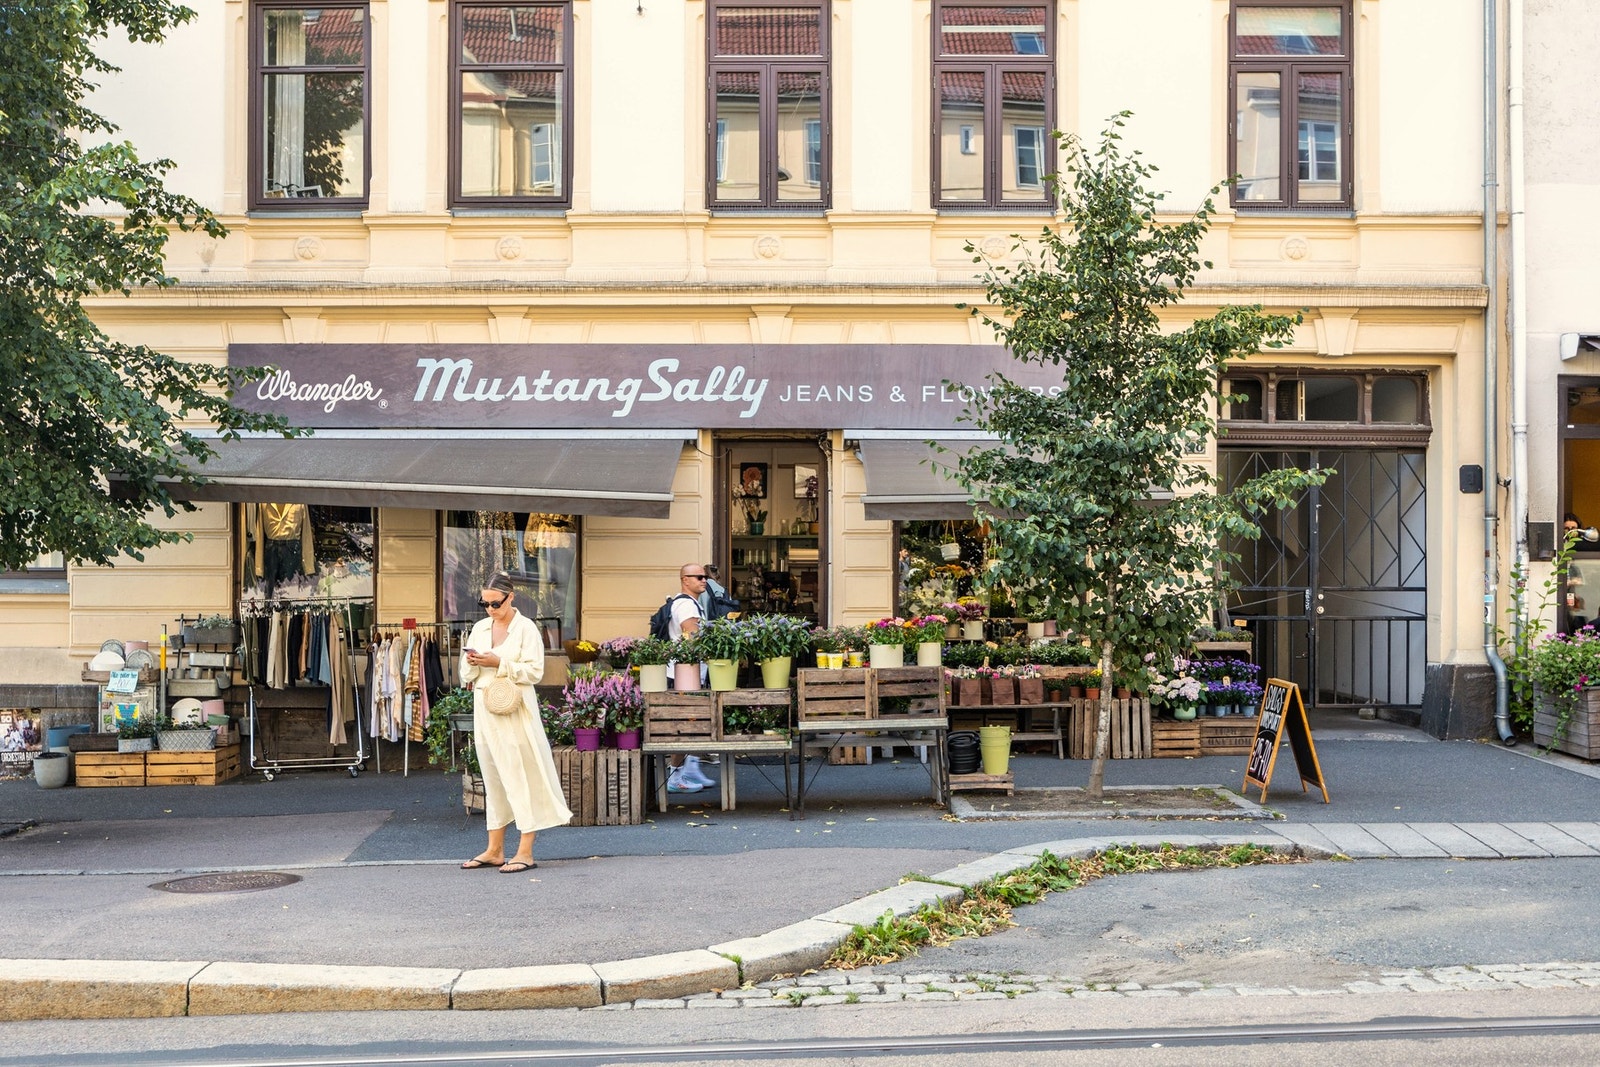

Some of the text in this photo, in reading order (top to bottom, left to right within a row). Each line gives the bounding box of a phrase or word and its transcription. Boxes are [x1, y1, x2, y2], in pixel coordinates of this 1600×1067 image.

[779, 384, 874, 402] JEANS
[889, 385, 906, 402] &
[620, 761, 629, 815] HOLLAND
